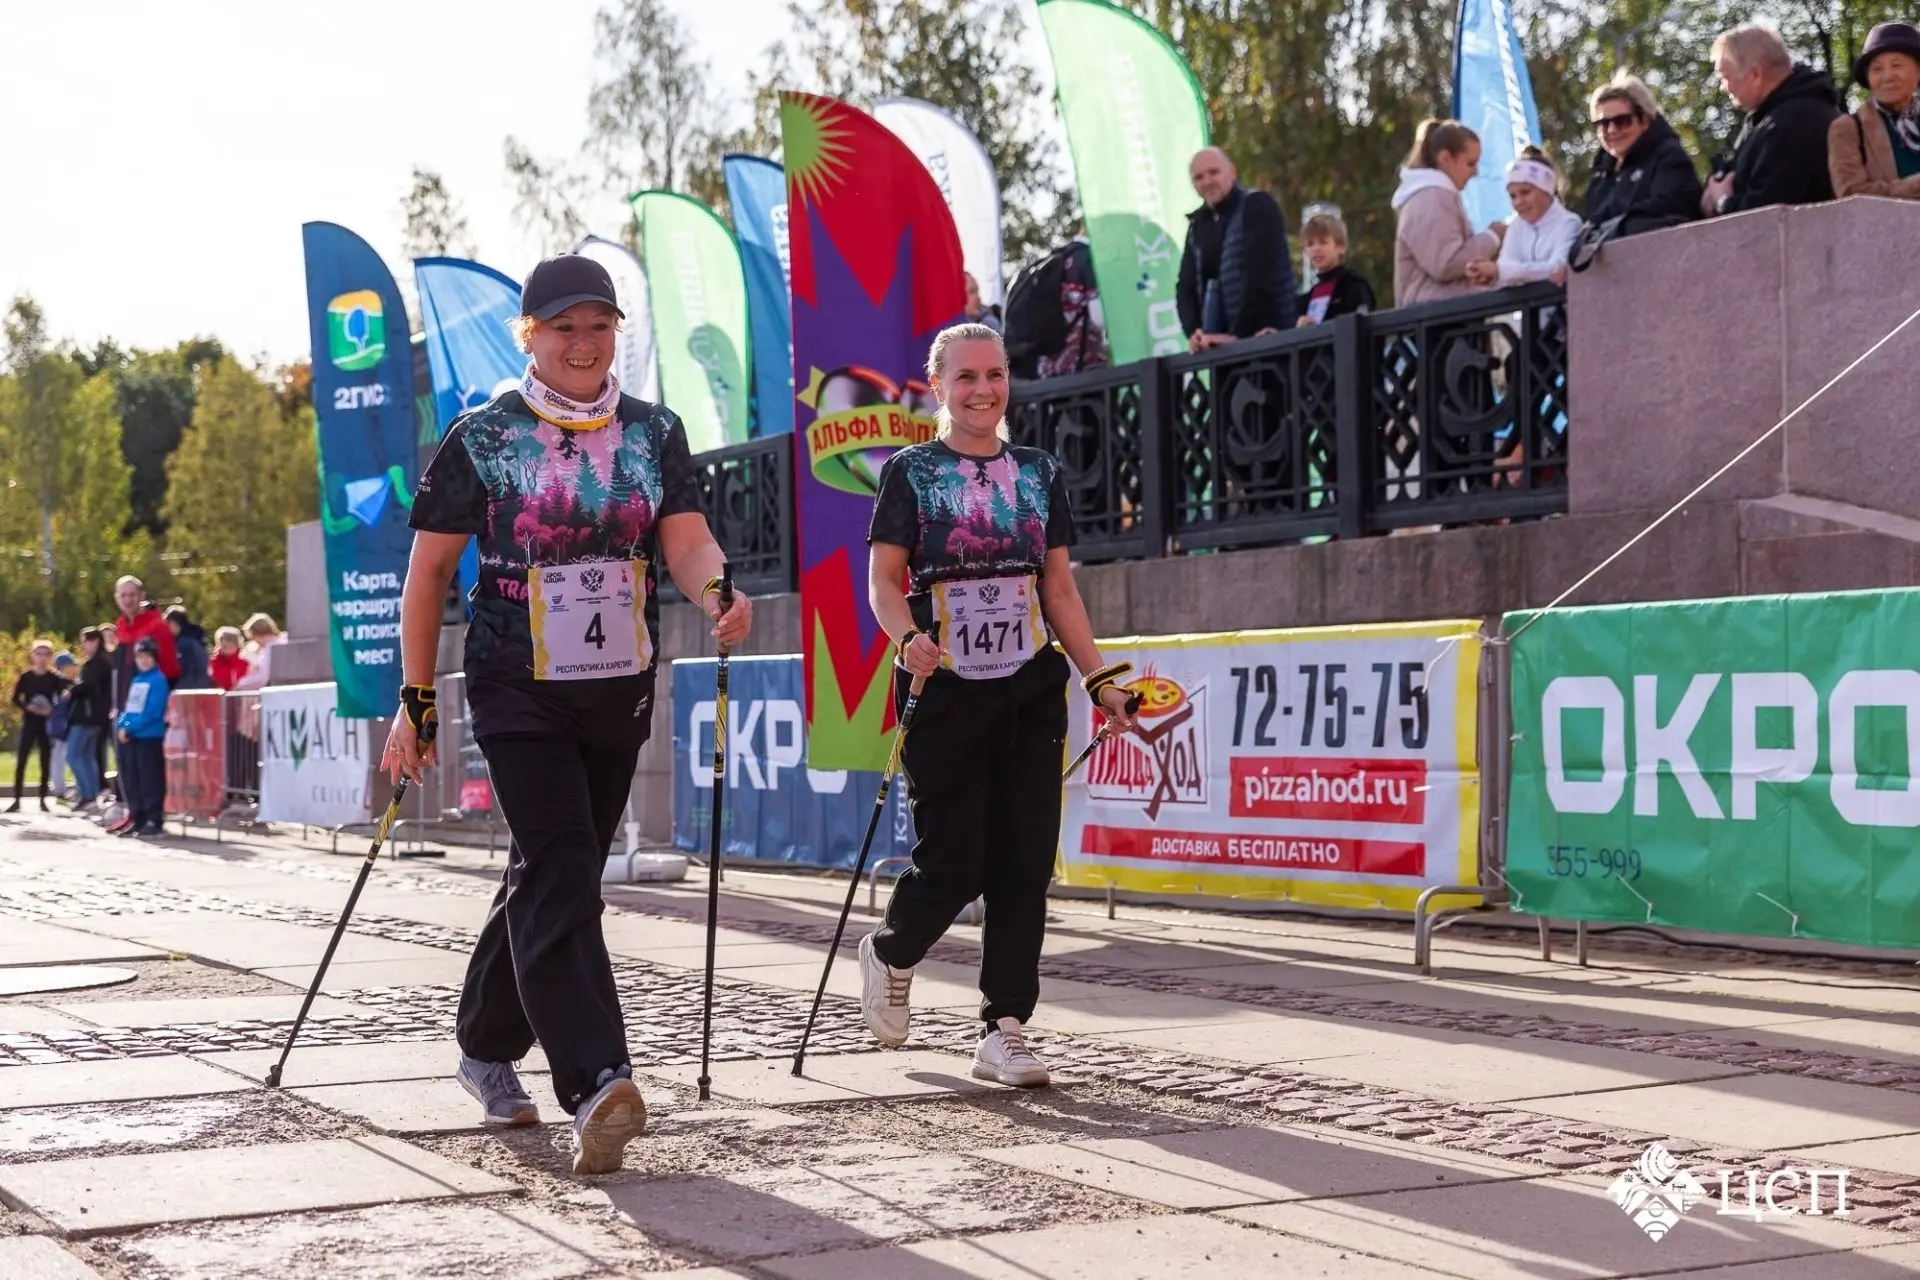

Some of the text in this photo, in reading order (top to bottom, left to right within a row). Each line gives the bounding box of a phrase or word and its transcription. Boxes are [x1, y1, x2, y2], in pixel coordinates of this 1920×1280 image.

[812, 414, 882, 455] АЛЬФА
[342, 569, 401, 594] Карта,
[342, 625, 354, 641] и
[584, 612, 606, 650] 4
[956, 619, 1025, 657] 1471
[354, 648, 394, 665] мест
[555, 659, 632, 674] РЕСПУБЛИКА КАРЕЛИЯ
[958, 663, 999, 672] РЕСПУБЛИКА
[1230, 661, 1430, 749] 72-75-75
[1244, 766, 1408, 807] pizzahod.ru
[1151, 835, 1340, 864] ДОСТАВКА БЕСПЛАТНО
[1547, 845, 1641, 881] 555-999
